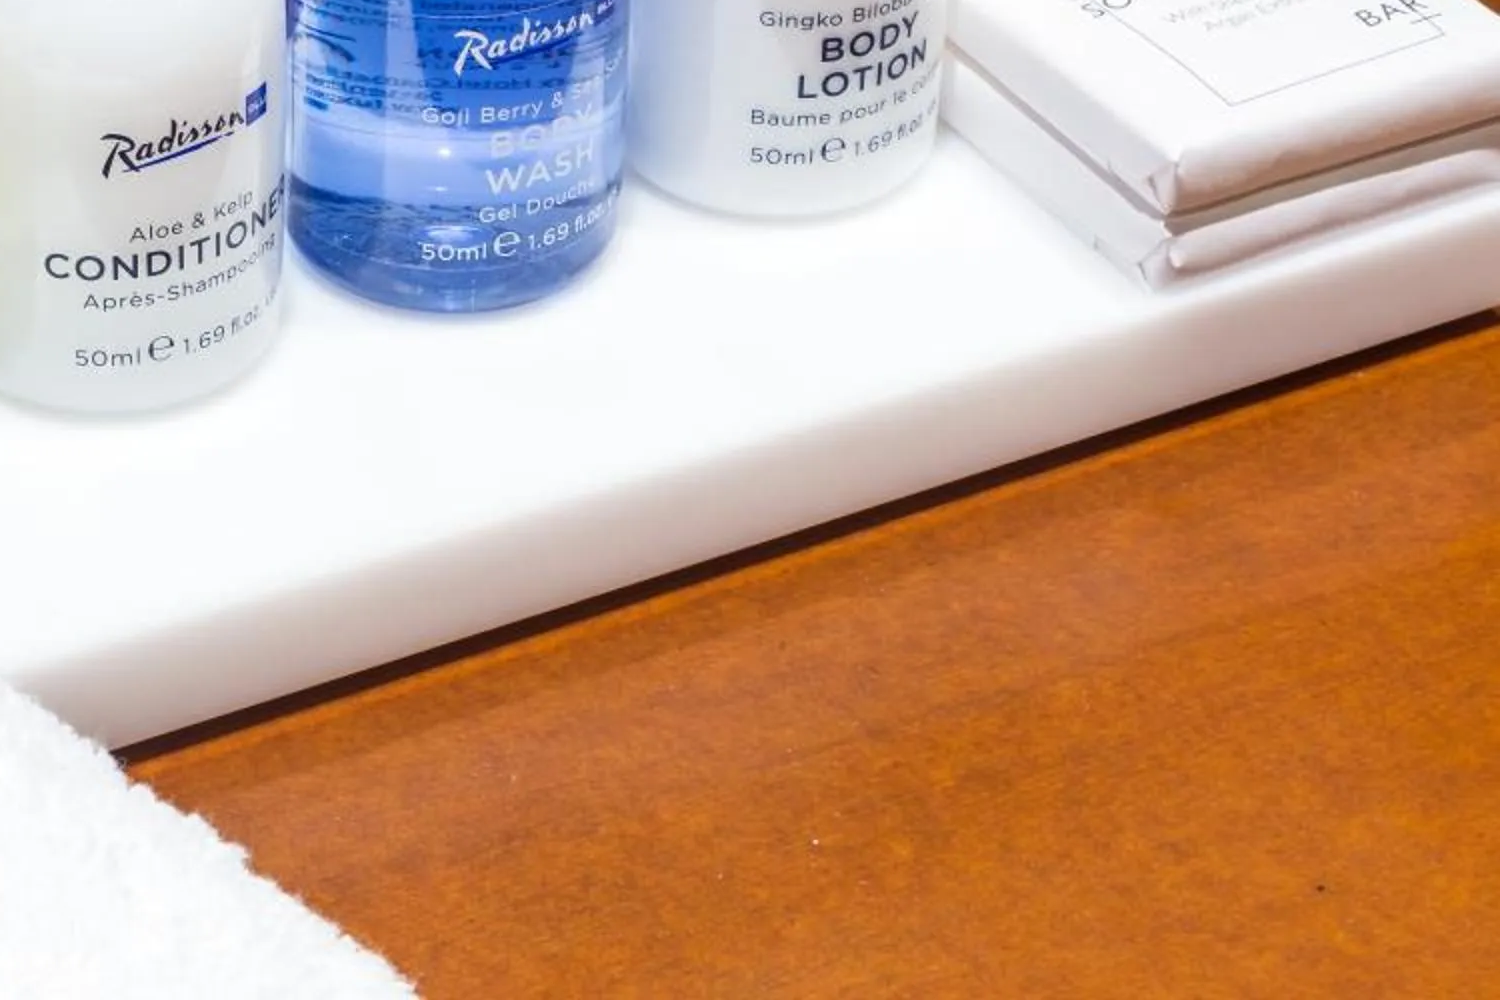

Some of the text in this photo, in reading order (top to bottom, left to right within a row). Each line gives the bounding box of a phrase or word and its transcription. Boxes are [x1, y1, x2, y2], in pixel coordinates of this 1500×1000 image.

[759, 10, 844, 30] Gingko
[820, 10, 919, 63] BODY
[453, 10, 594, 77] Radisson
[797, 39, 927, 100] LOTION
[421, 91, 565, 128] Goji Berry &
[750, 108, 832, 127] Baume
[840, 98, 886, 124] pour
[100, 109, 245, 178] Radisson
[749, 147, 814, 165] 50ml
[485, 137, 594, 197] WASH
[128, 190, 254, 244] Aloe & Kelp
[478, 203, 517, 224] Gel
[419, 241, 488, 263] 50ml
[527, 221, 569, 250] 1.69
[74, 348, 142, 368] 50ml
[183, 325, 226, 354] 1.69
